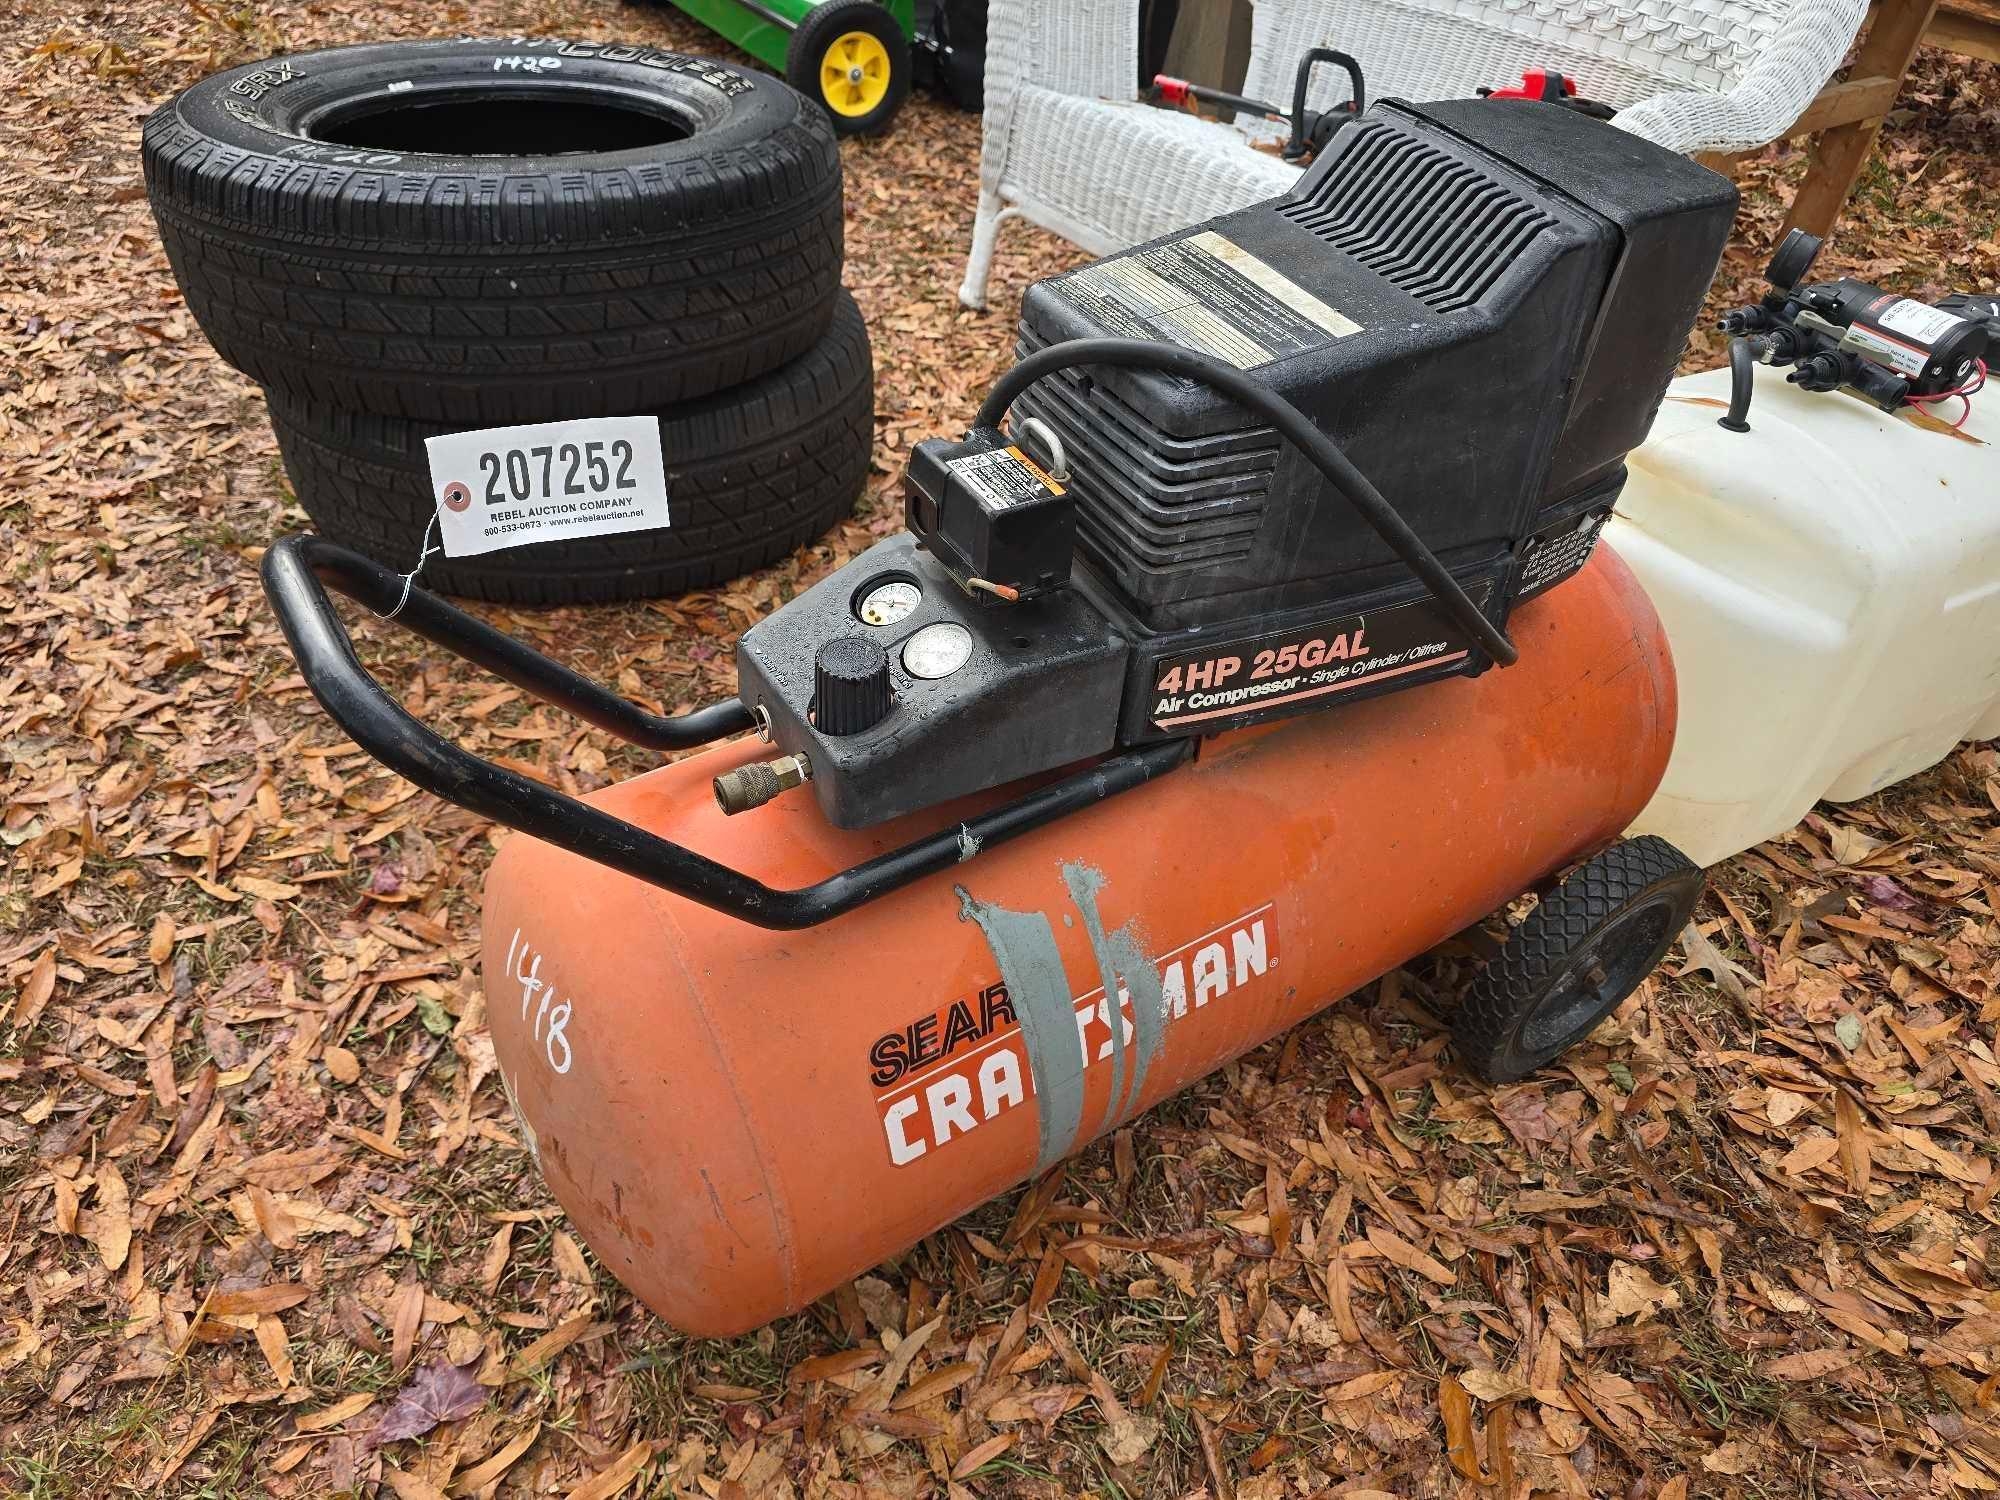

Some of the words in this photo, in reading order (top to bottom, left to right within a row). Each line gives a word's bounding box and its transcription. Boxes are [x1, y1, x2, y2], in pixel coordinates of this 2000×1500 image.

[479, 439, 637, 506] 207252
[484, 519, 542, 537] 800-533-0673
[548, 508, 645, 527] www.rebelauction.net
[490, 509, 526, 523] REBEL
[528, 502, 577, 519] AUCTION
[579, 496, 633, 512] COMPANY
[1154, 695, 1186, 715] Air
[1187, 675, 1300, 709] Compressor
[1309, 665, 1350, 685] Single
[1351, 652, 1404, 675] Cylinder
[1409, 640, 1448, 660] Oilfree
[1157, 655, 1242, 696] 4HP
[1249, 629, 1372, 681] 25GAL
[505, 926, 573, 1075] 1418
[869, 979, 1021, 1088] SEAR
[883, 919, 1269, 1167] CRATSMAN
